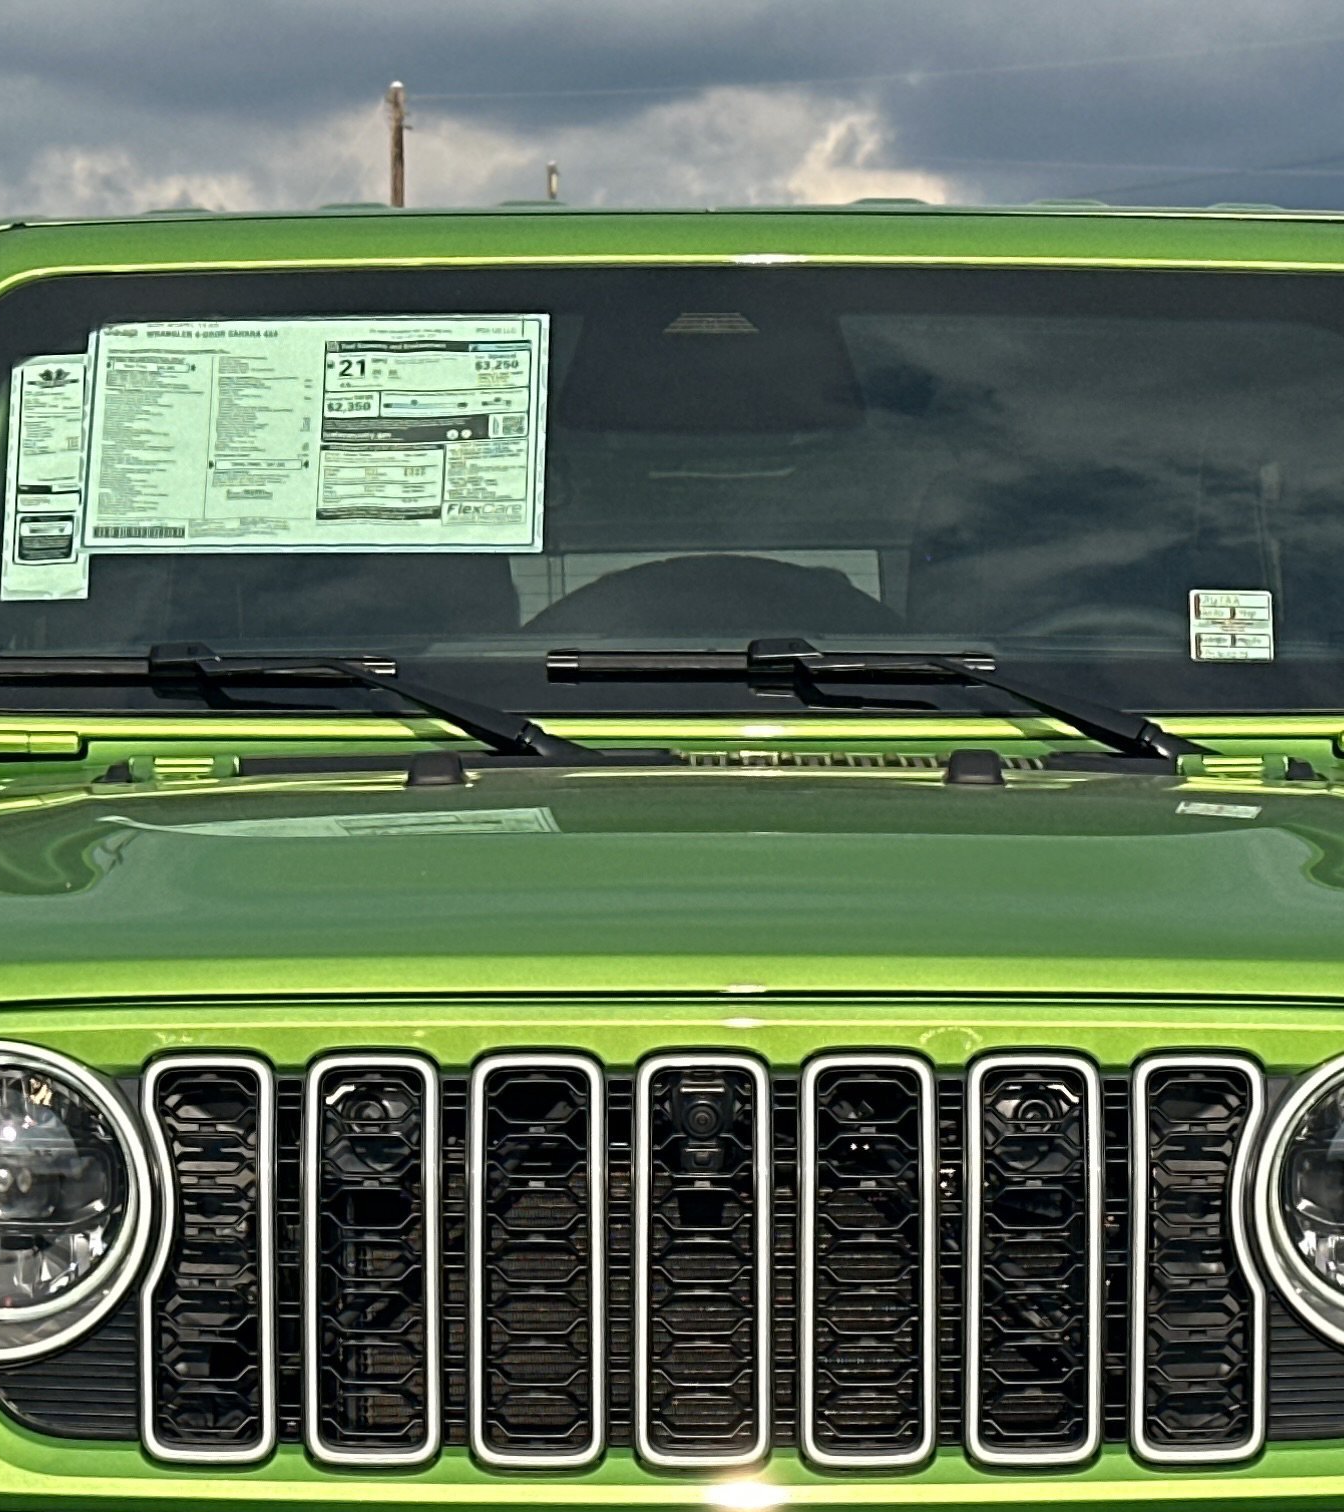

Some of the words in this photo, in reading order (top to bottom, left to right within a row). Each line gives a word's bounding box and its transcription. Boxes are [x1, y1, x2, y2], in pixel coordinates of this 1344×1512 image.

[338, 358, 366, 378] 21
[475, 360, 520, 371] $3,250
[327, 401, 371, 413] $2,350
